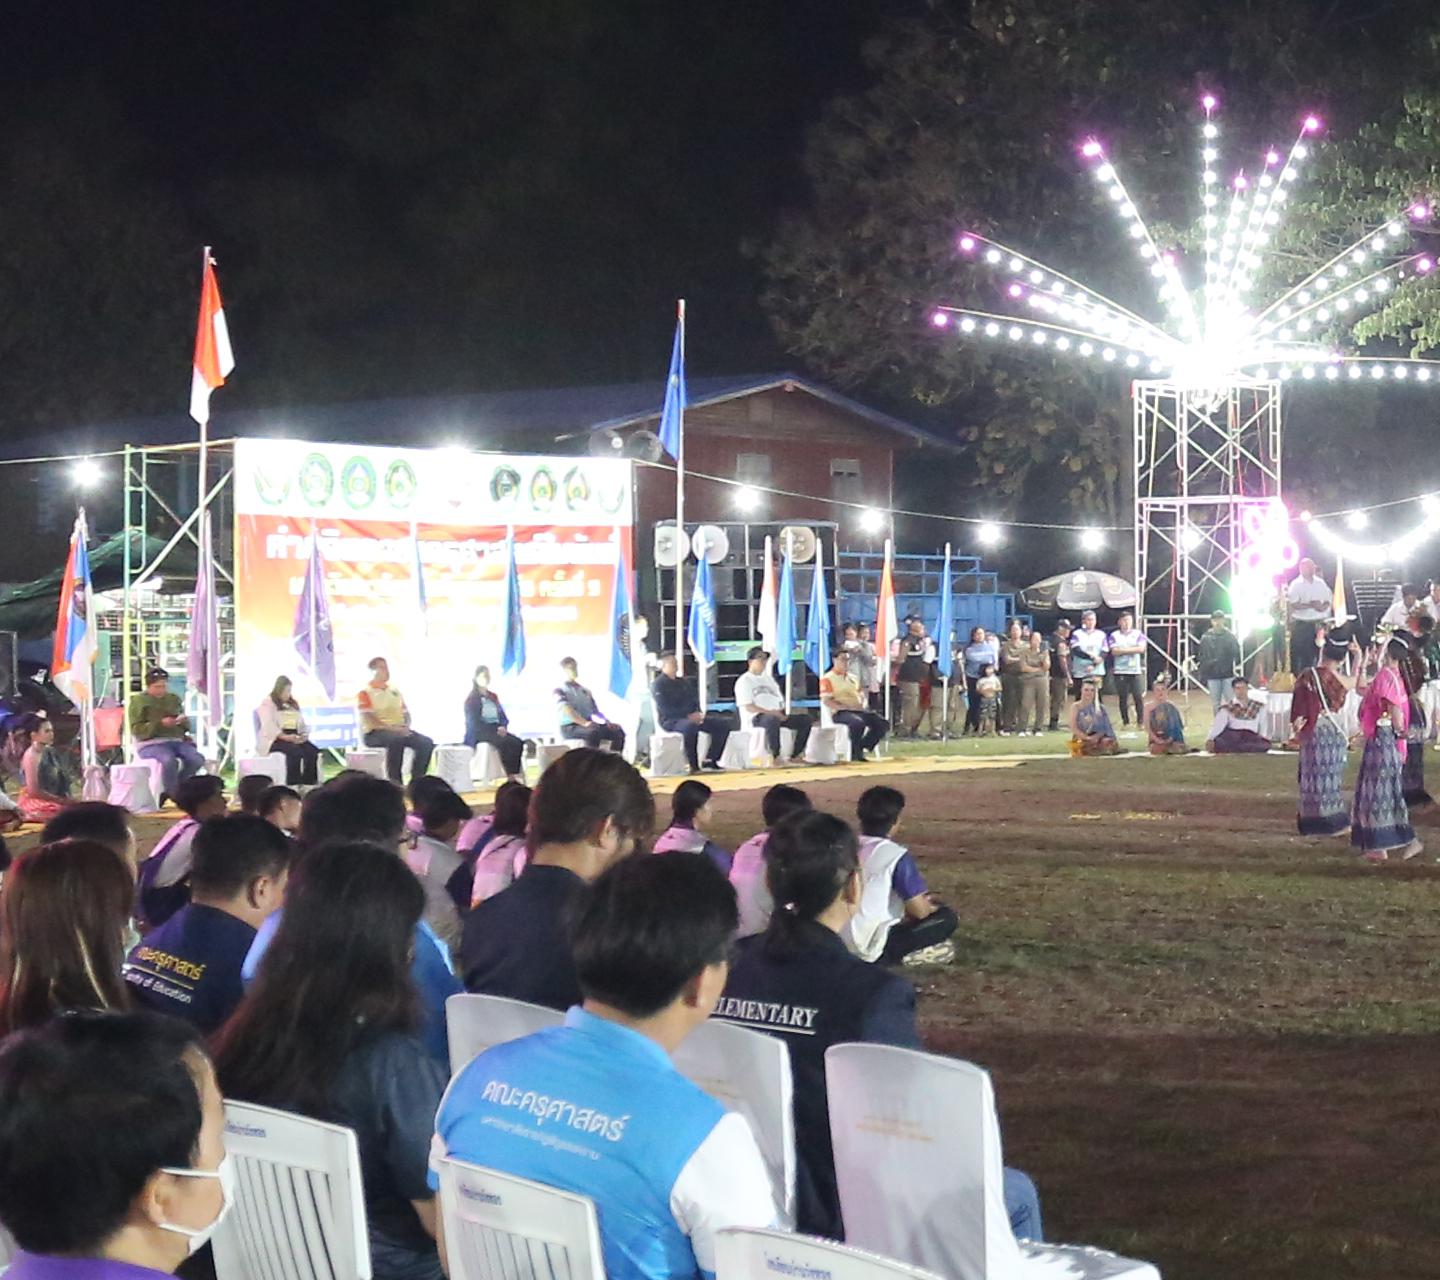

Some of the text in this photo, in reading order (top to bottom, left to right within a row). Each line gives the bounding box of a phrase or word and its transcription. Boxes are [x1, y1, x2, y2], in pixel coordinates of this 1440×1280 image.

[480, 1080, 632, 1142] คณะครุศาสตร์
